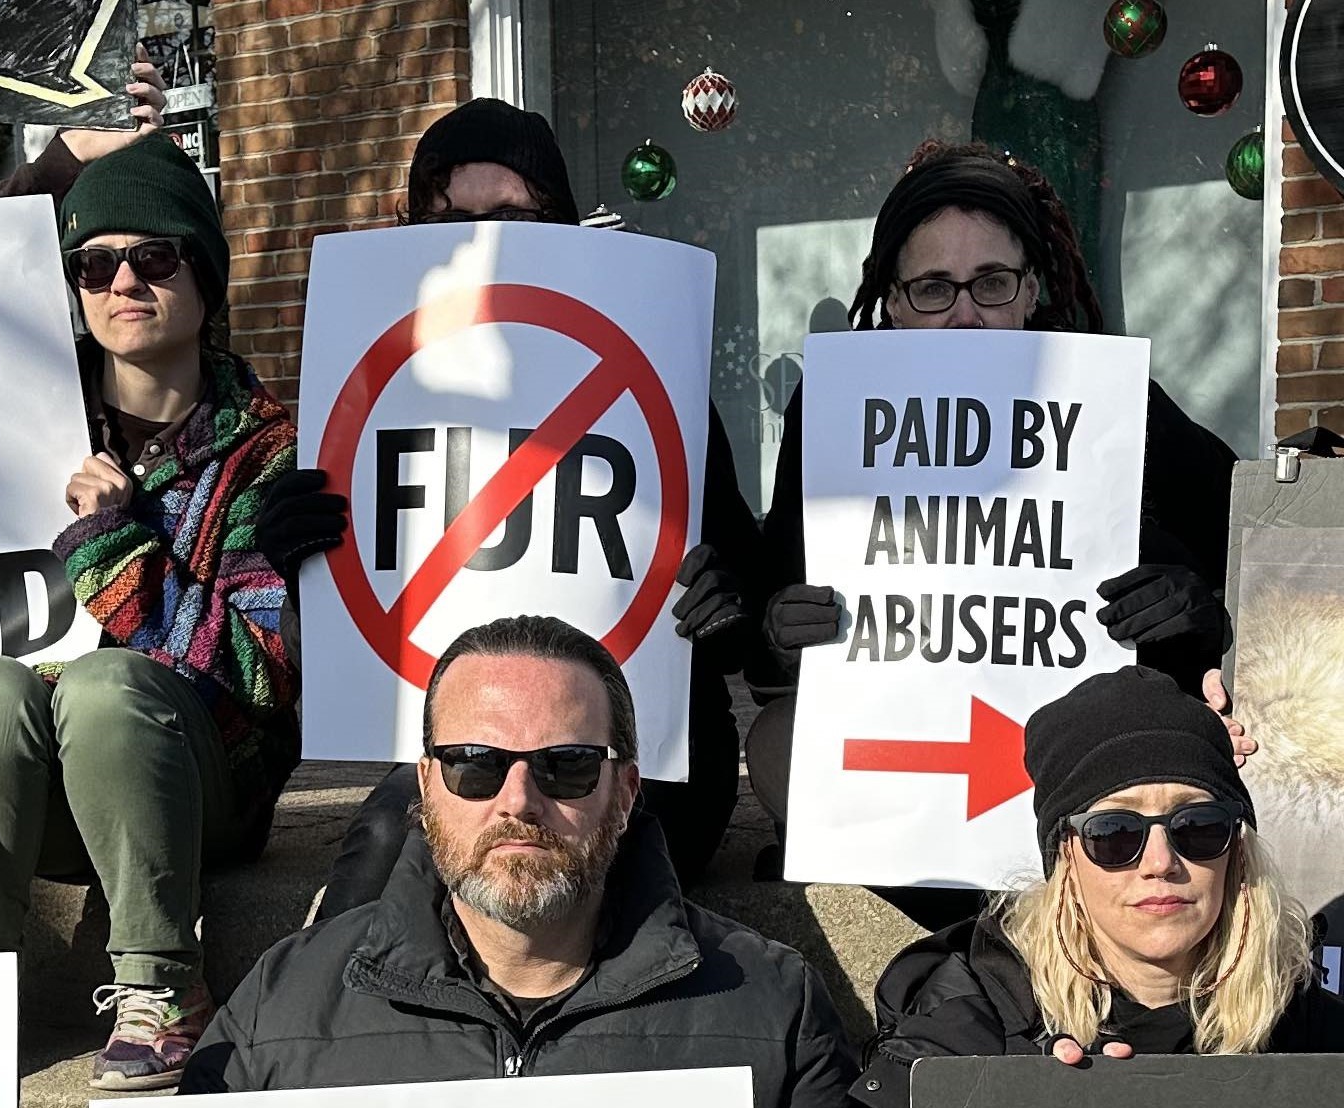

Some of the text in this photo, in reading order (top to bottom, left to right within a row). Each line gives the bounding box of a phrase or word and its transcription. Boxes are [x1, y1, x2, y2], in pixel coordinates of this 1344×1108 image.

[166, 90, 203, 110] OPEN
[863, 398, 1083, 472] PAID BY
[374, 427, 637, 581] FUR
[864, 495, 1073, 571] ANIMAL
[846, 594, 1087, 669] ABUSERS
